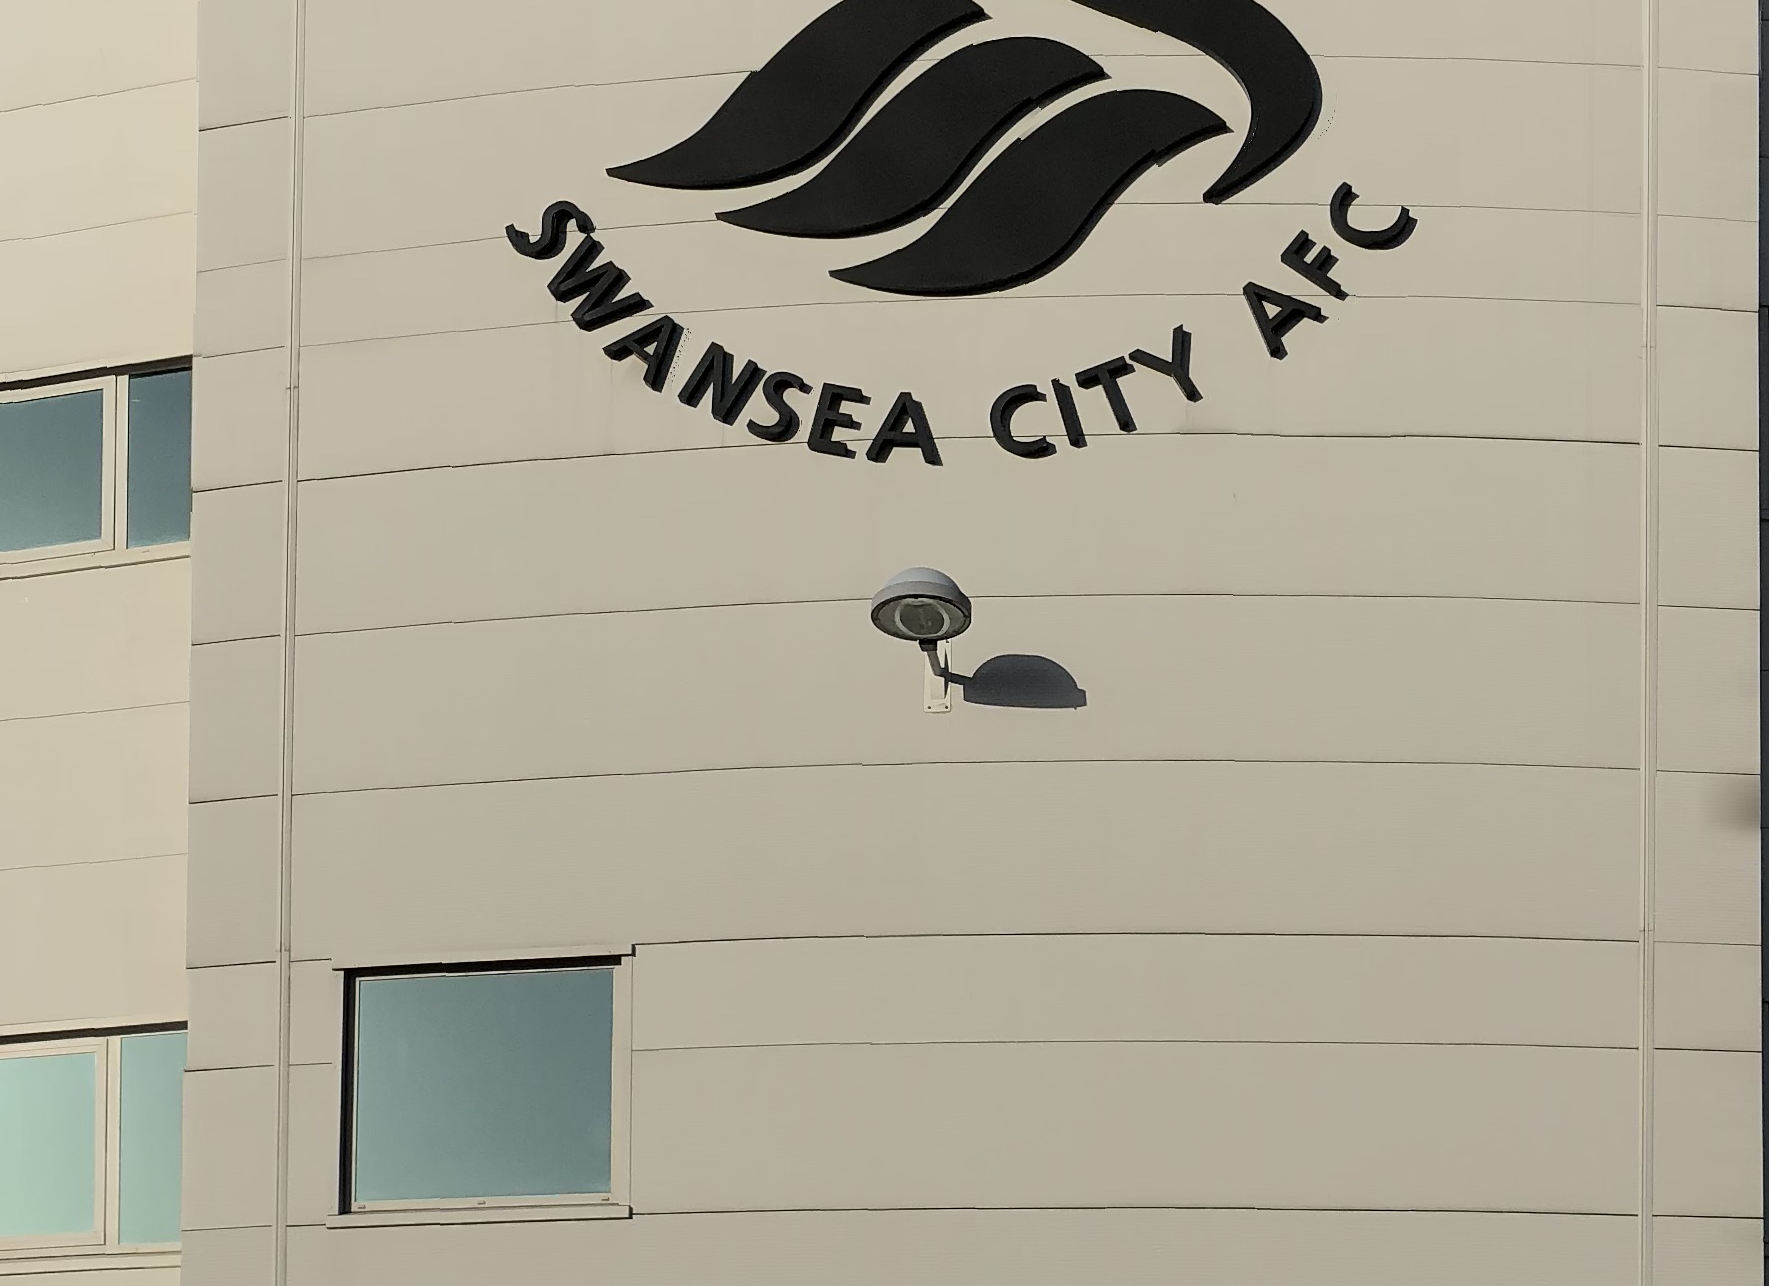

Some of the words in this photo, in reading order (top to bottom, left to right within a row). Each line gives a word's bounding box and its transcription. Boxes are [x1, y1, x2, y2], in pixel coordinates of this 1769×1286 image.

[505, 199, 942, 466] SWANSEA
[989, 324, 1202, 458] CITY
[1243, 181, 1418, 360] AFC
